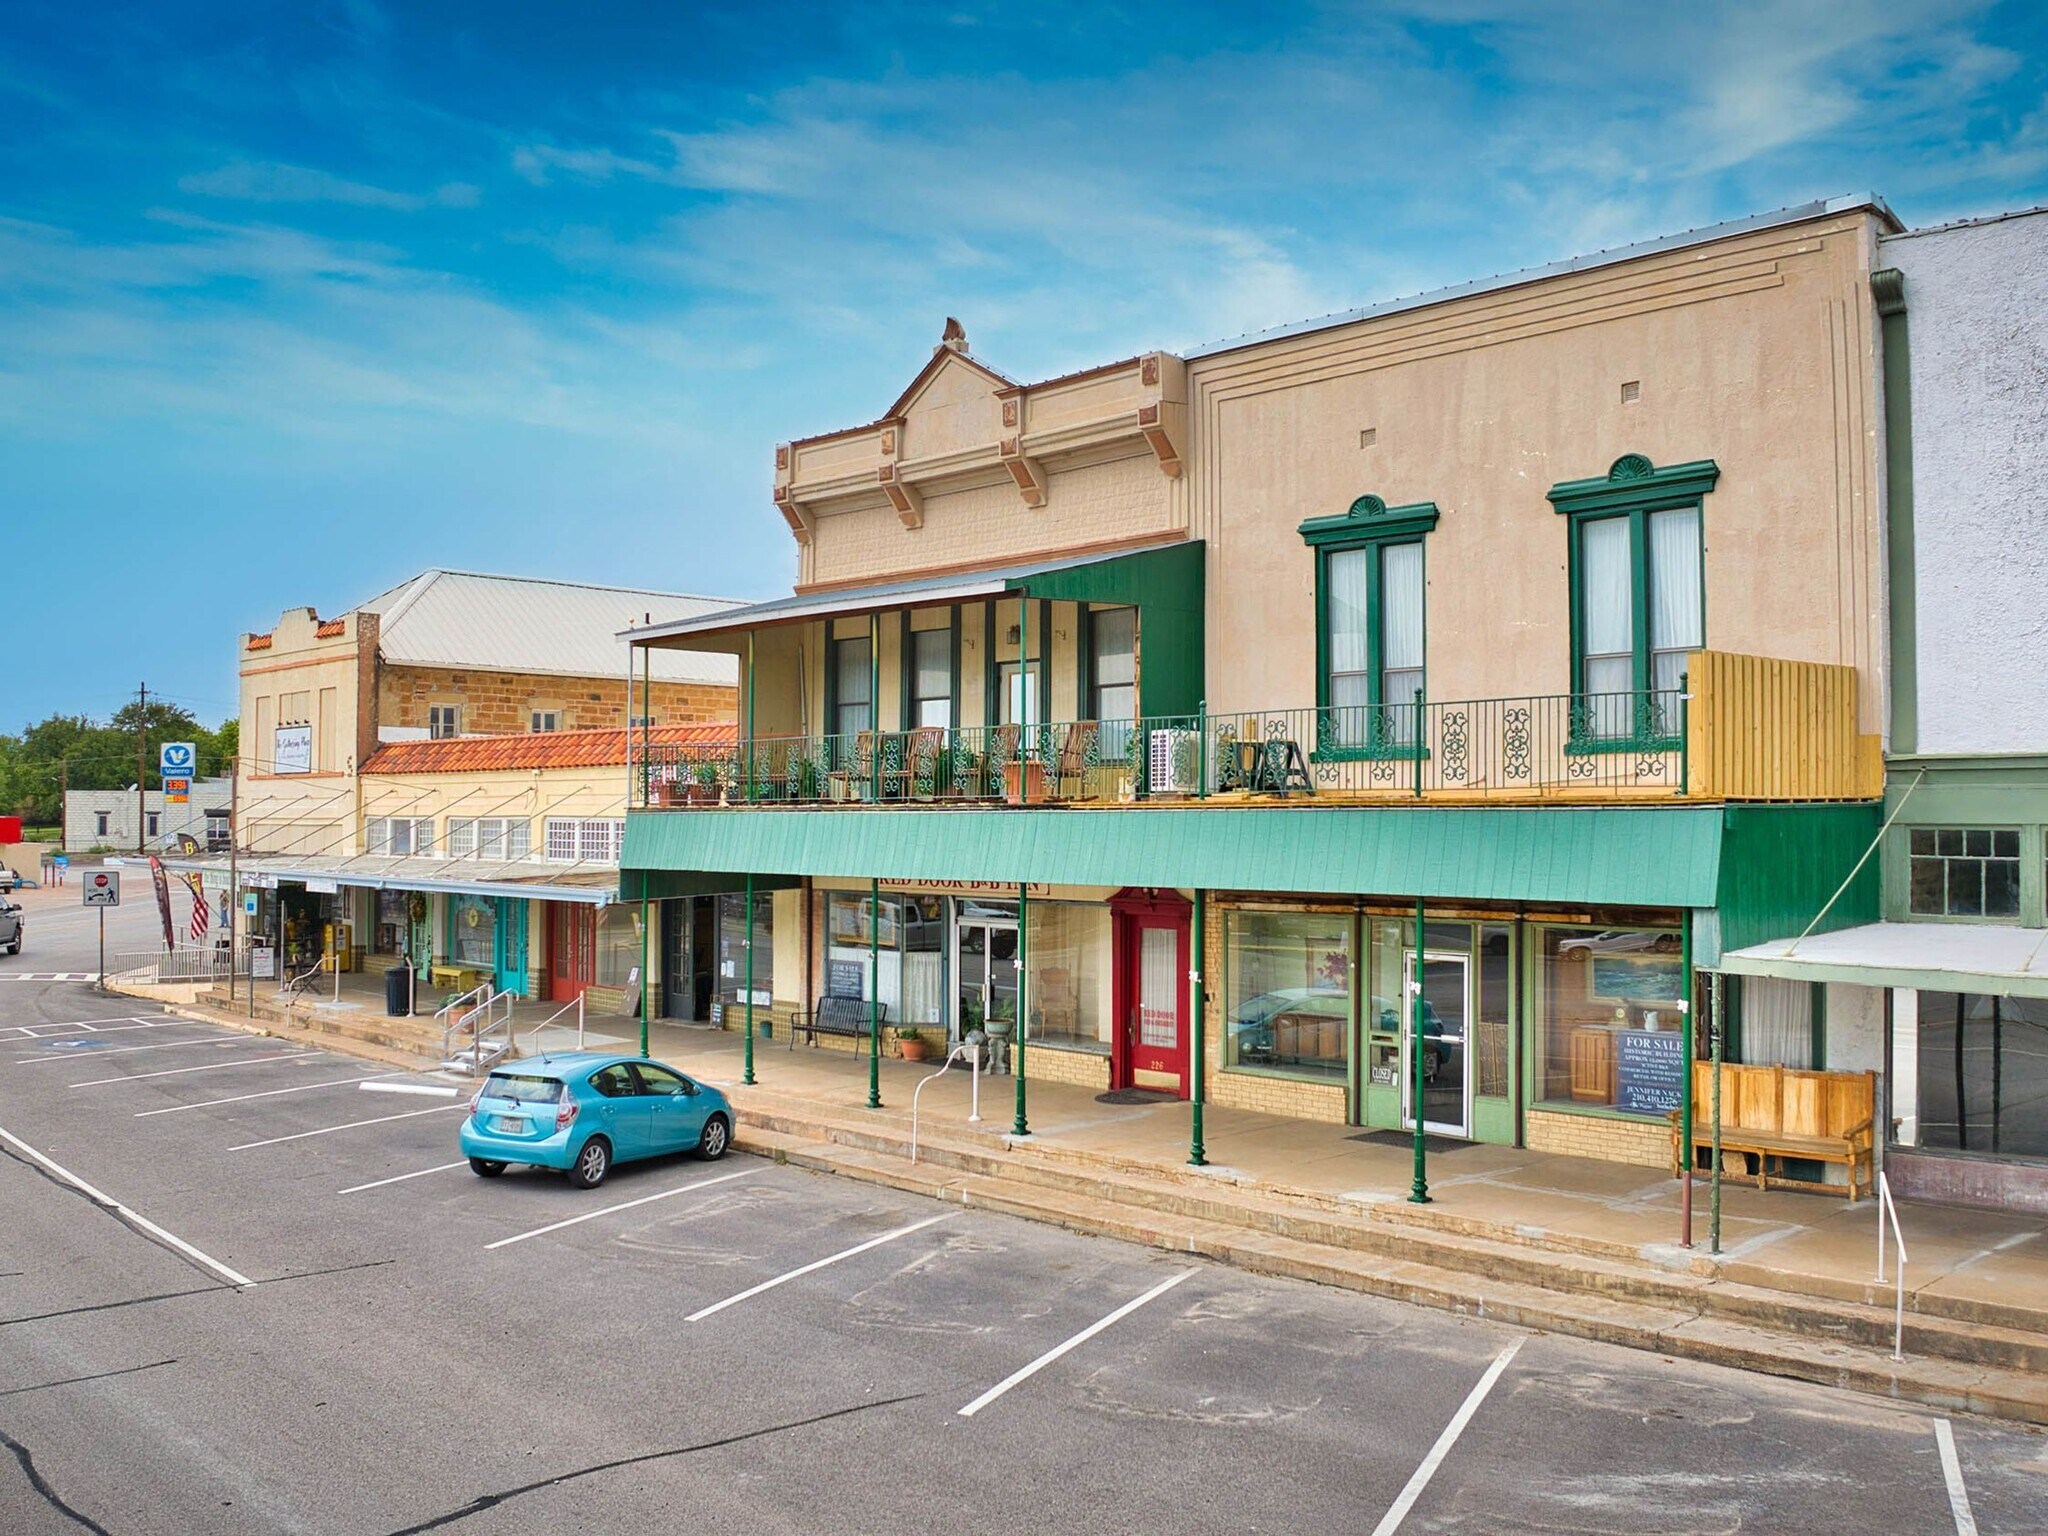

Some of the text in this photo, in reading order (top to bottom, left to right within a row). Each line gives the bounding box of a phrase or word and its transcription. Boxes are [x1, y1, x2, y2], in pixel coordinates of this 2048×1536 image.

[165, 767, 190, 775] Valero
[1627, 1037, 1684, 1051] FOR SALE
[1151, 1060, 1164, 1070] 226
[1372, 1067, 1391, 1080] CLOSED
[1627, 1086, 1660, 1095] JENNIFER
